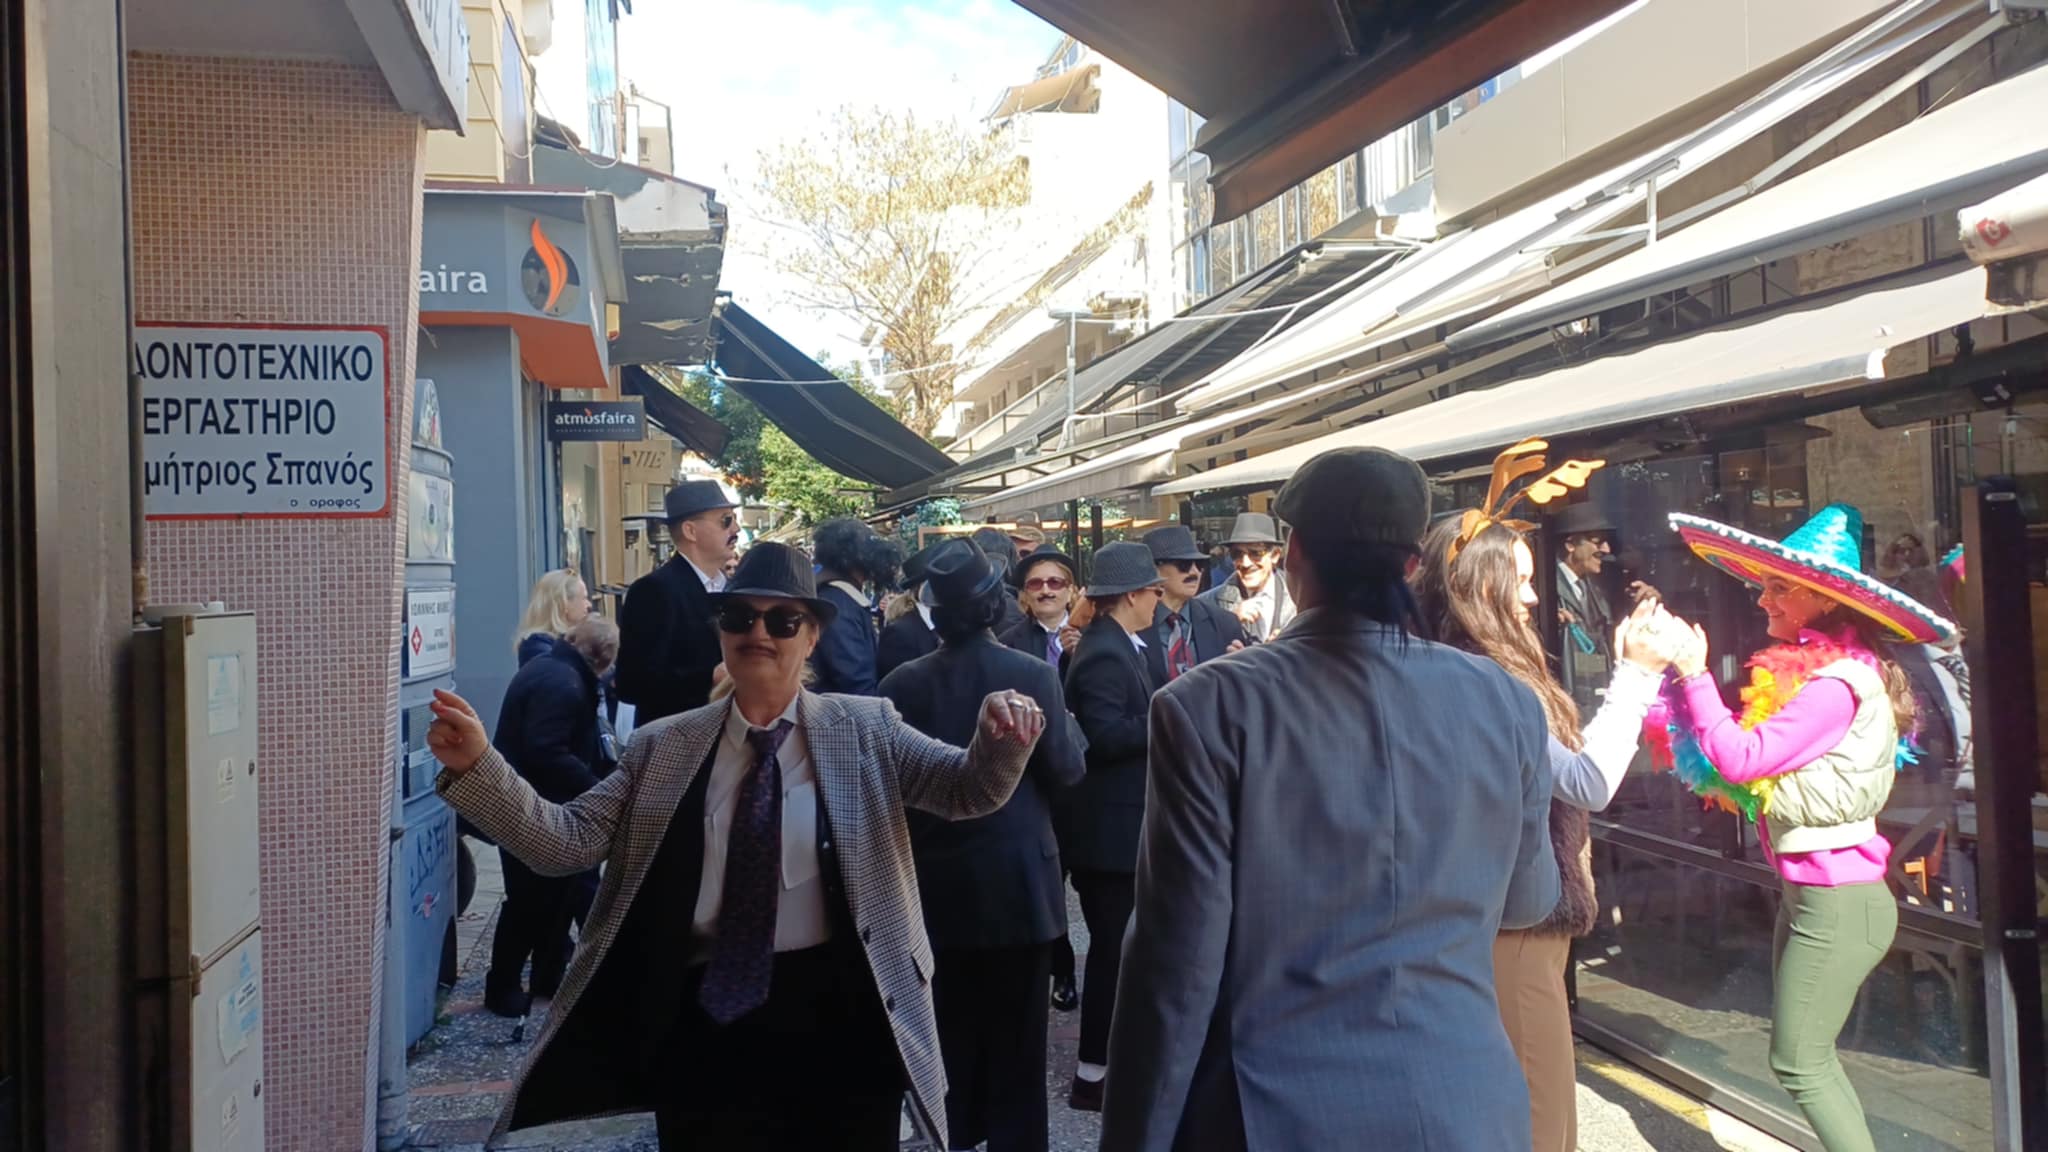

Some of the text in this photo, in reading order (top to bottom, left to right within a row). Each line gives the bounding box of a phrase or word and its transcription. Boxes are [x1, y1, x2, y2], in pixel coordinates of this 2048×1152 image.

[143, 398, 336, 435] ΕΡΓΑΣΤΗΡΙΟ
[144, 452, 373, 495] μήτριος Σπανός
